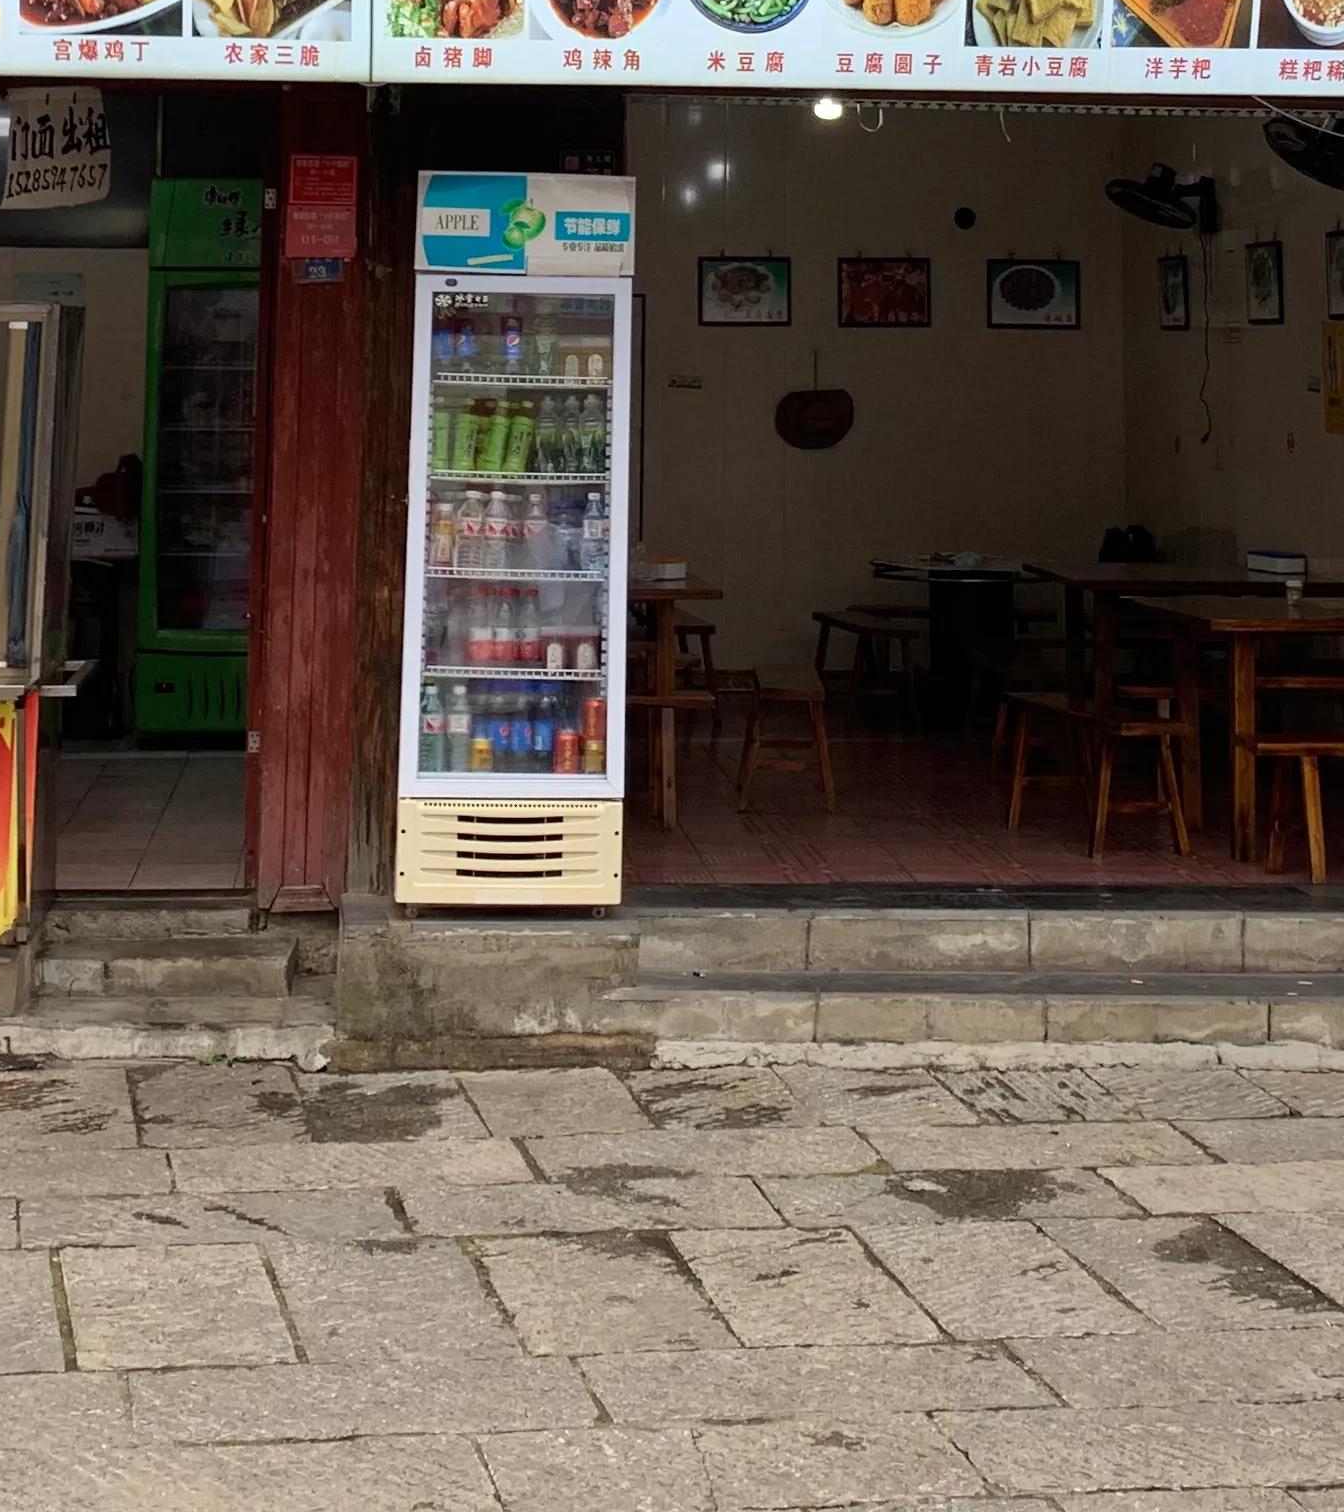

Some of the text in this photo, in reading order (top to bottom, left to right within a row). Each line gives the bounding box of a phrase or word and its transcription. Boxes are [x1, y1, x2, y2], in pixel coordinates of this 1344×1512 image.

[53, 38, 151, 64] 宫爆鸡丁
[223, 42, 322, 68] 农家三脆
[414, 45, 494, 71] 卤猪脚
[562, 47, 642, 73] 鸡辣角
[707, 49, 786, 74] 米豆腐
[836, 51, 944, 76] 豆腐圆子
[974, 53, 1089, 80] 青岩小豆腐
[1144, 55, 1213, 81] 洋芋粑
[11, 105, 113, 161] 门面出租
[434, 214, 480, 231] APPLE
